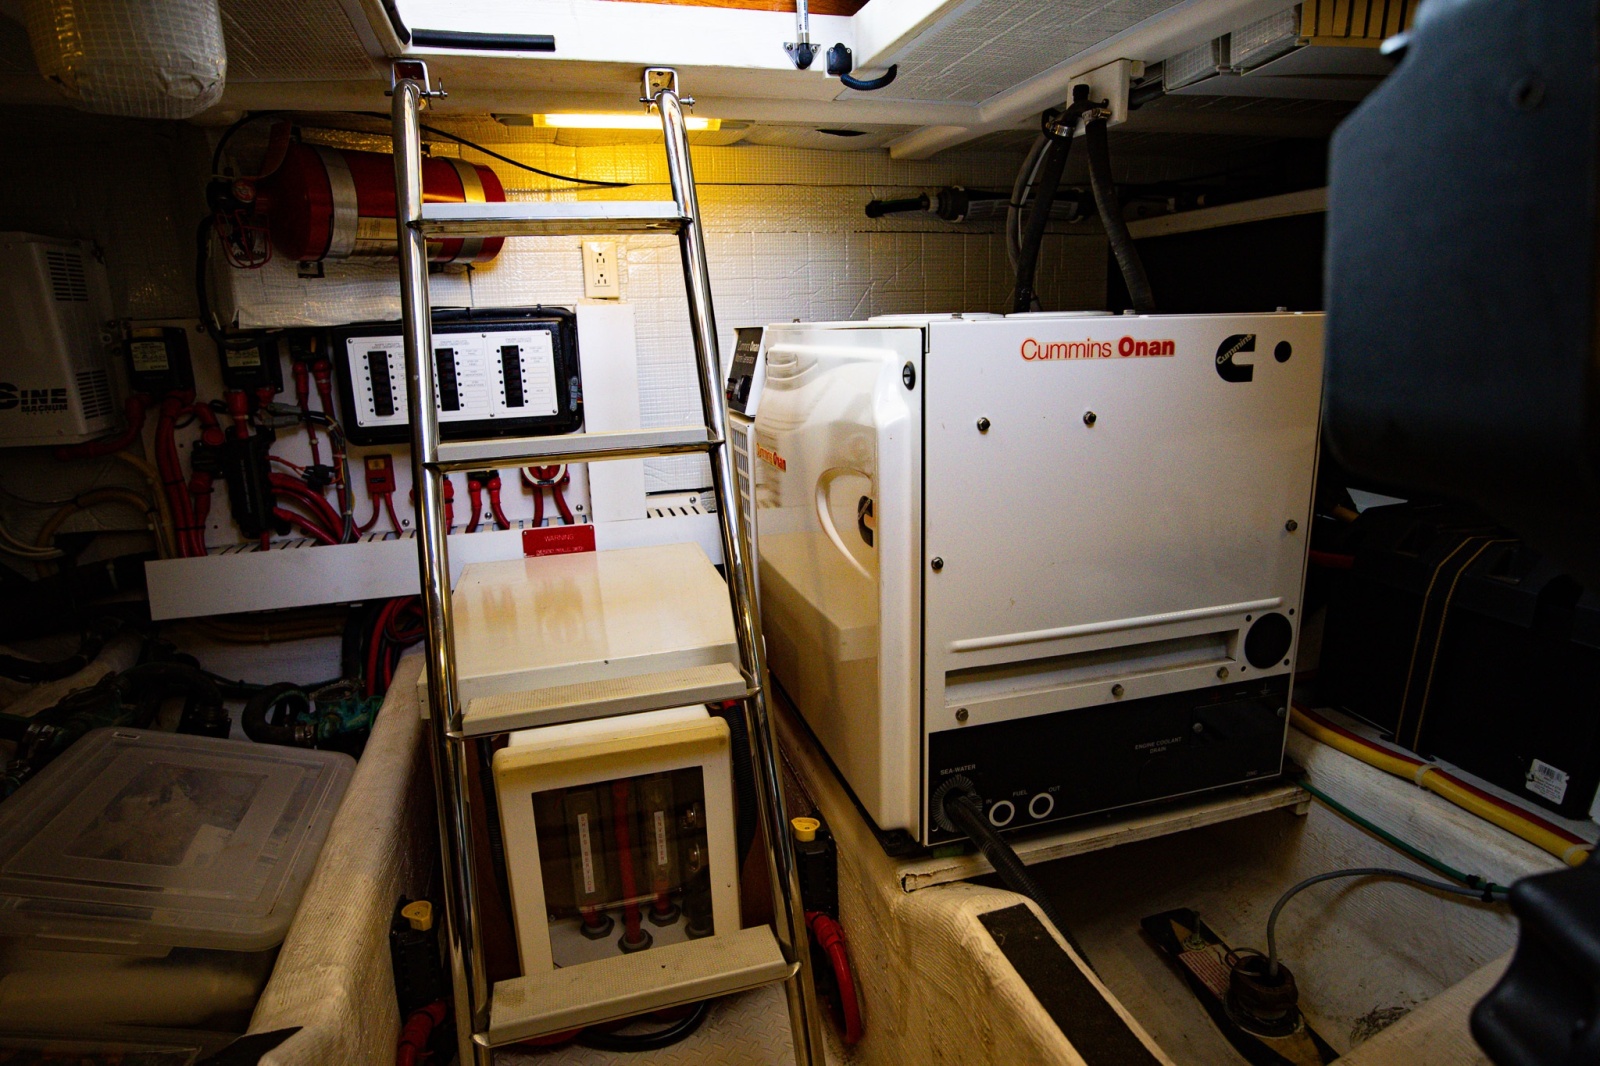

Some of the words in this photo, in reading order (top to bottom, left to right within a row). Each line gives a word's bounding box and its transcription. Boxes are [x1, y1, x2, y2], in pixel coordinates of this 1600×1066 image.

[1021, 338, 1112, 361] Cummins
[1118, 336, 1175, 357] Onan
[1216, 333, 1253, 365] Cummins
[21, 403, 68, 412] MAGNUM
[544, 534, 574, 542] WARNING
[1134, 741, 1155, 750] ENGINE
[1156, 736, 1182, 746] COOLANT
[1149, 746, 1167, 754] DRAIN
[939, 763, 976, 775] SEA-WATER
[1012, 789, 1028, 797] FUEL
[1048, 785, 1061, 793] OUT
